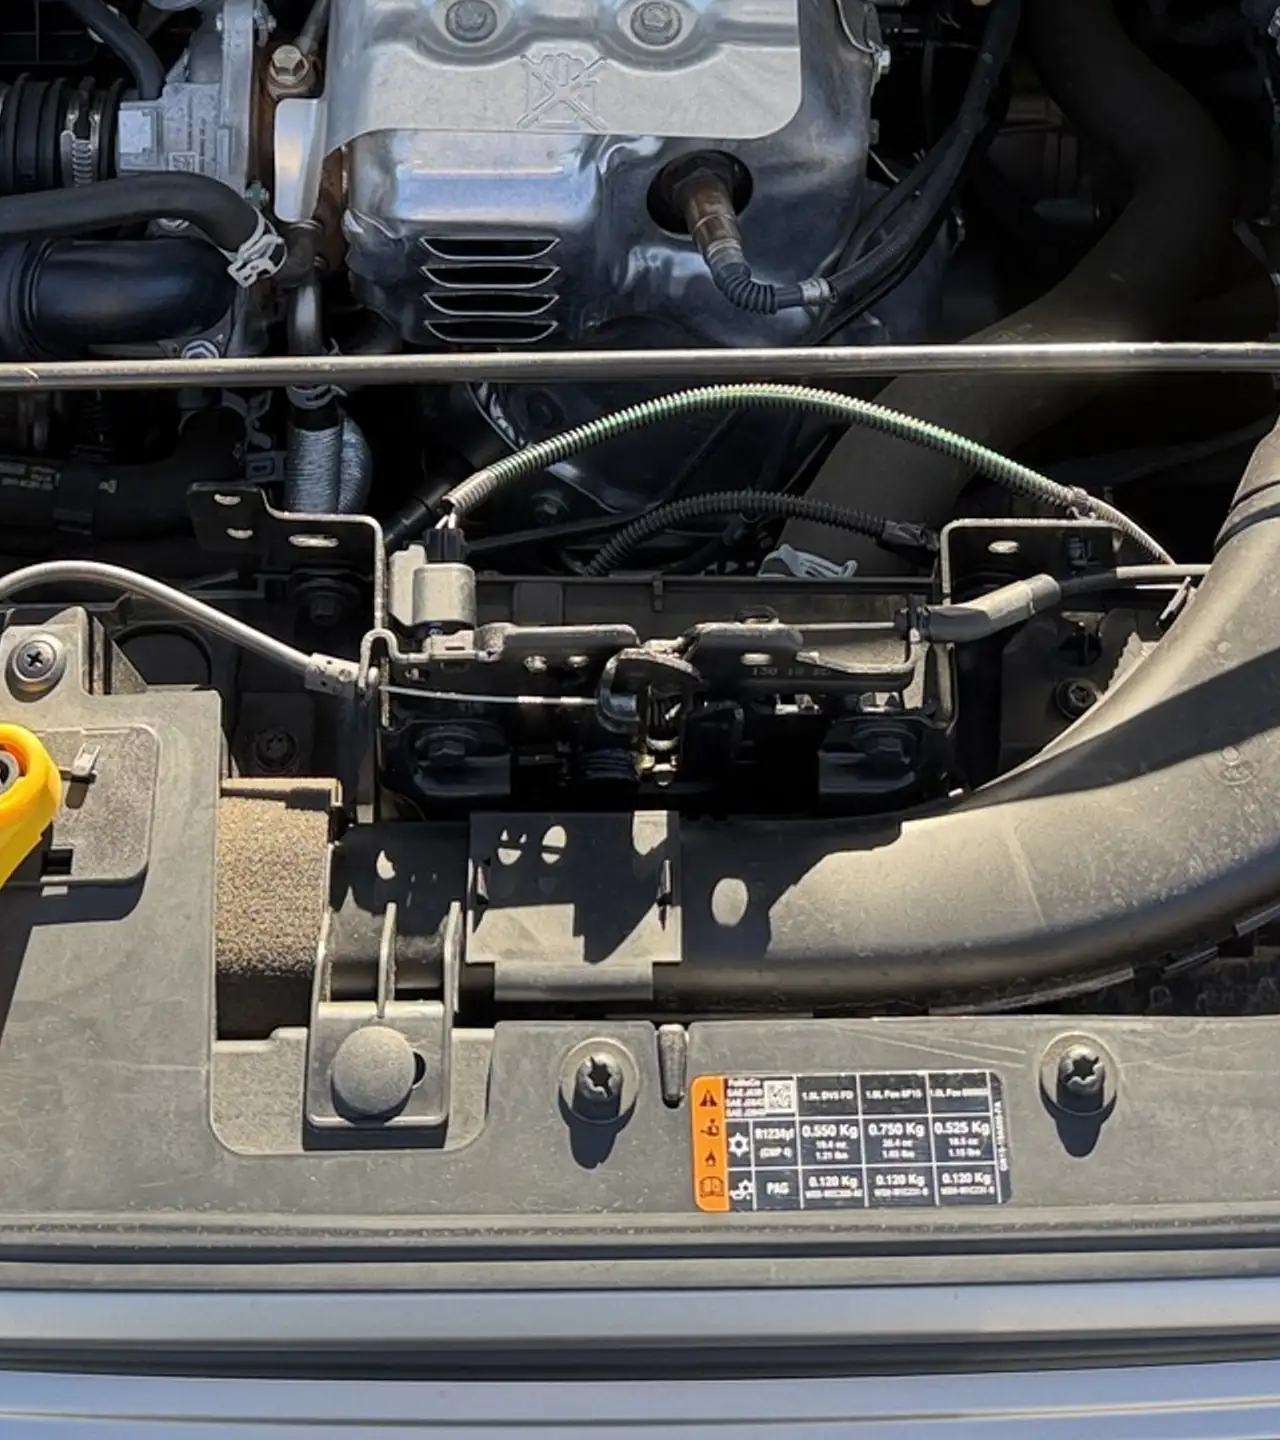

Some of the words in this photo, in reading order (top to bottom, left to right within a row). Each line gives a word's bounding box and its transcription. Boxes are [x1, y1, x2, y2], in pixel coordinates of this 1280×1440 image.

[801, 1123, 837, 1138] 0.550
[839, 1123, 859, 1140] Kg
[868, 1122, 903, 1137] 0.750
[905, 1122, 926, 1138] Kg
[934, 1120, 969, 1135] 0.525
[971, 1120, 991, 1137] Kg
[808, 1175, 839, 1188] 0.120
[840, 1175, 858, 1189] Kg
[875, 1174, 907, 1186] 0.120
[908, 1173, 926, 1188] Kg
[941, 1172, 973, 1184] 0.120
[974, 1172, 992, 1186] Kg
